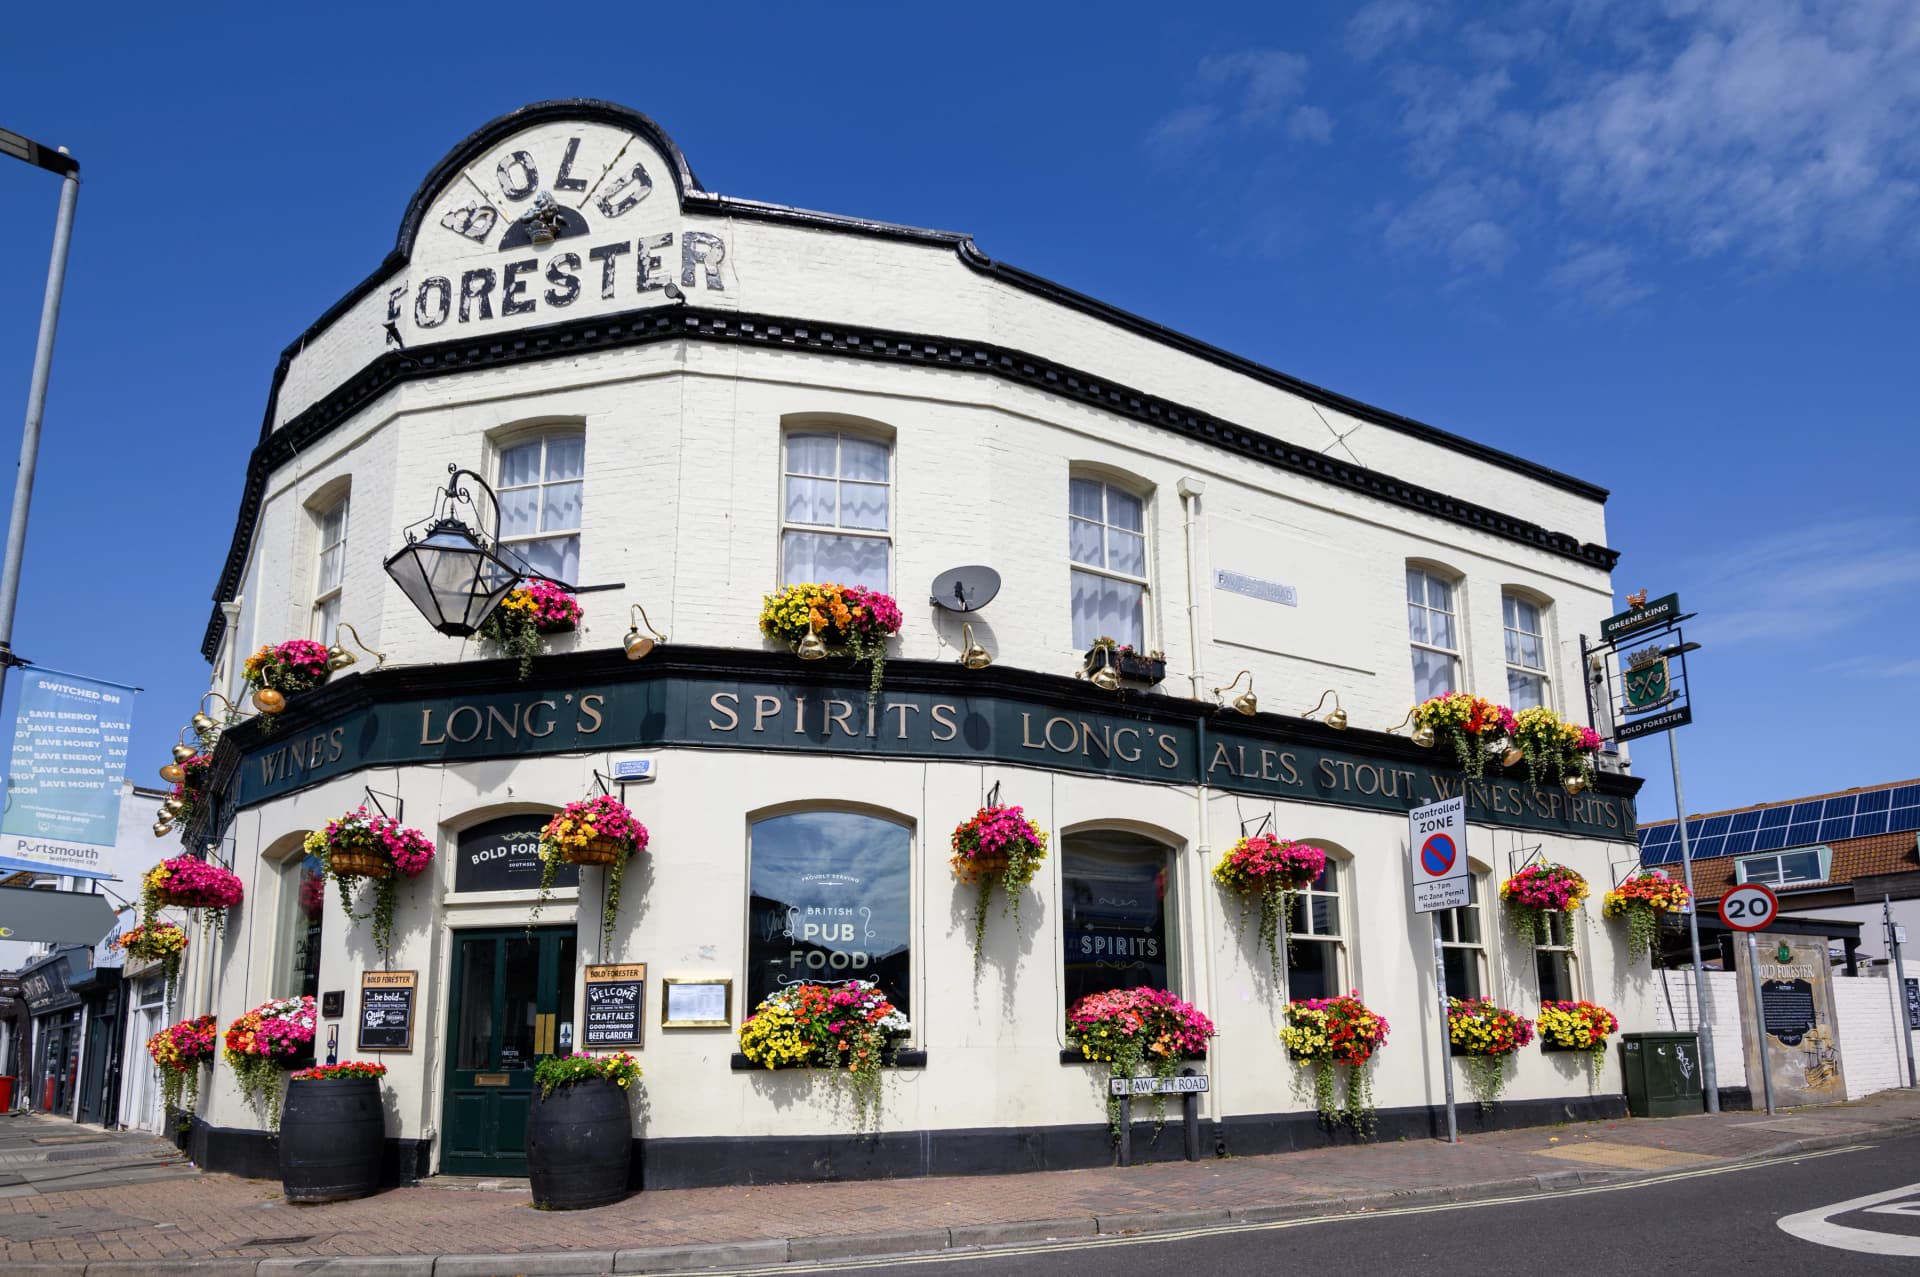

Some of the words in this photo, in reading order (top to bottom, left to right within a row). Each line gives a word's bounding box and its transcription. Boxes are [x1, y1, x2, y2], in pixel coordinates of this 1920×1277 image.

[441, 137, 653, 244] BOLD
[1608, 612, 1643, 631] GREENE
[1645, 604, 1669, 618] KING
[38, 681, 101, 700] SWITCHED
[102, 694, 121, 704] ON
[29, 710, 56, 719] SAVE
[58, 711, 98, 721] ENERGY
[420, 694, 605, 746] LONG'S
[709, 692, 957, 741] SPIRITS
[27, 724, 55, 732] SAVE
[56, 725, 100, 735] CARBON
[1621, 723, 1642, 736] BOLD
[1643, 713, 1684, 729] FORESTER
[35, 738, 62, 746] SAVE
[63, 739, 101, 749] MONEY
[104, 735, 129, 743] SAVE
[1021, 712, 1179, 768] LONG'S
[34, 752, 61, 760] SAVE
[62, 753, 103, 762] ENERGY
[260, 726, 344, 786] WINES
[32, 766, 58, 775] SAVE
[60, 767, 105, 776] CARBON
[40, 780, 67, 789] SAVE
[67, 781, 105, 790] MONEY
[1208, 742, 1304, 787] ALES,
[1431, 774, 1523, 816] WINES
[1535, 791, 1619, 829] SPIRITS
[1413, 801, 1461, 820] Controlled
[1420, 816, 1454, 833] ZONE
[17, 840, 99, 859] Portsmouth
[472, 846, 507, 864] BOLD
[1445, 888, 1464, 897] Permit
[1423, 901, 1445, 909] Holders
[1447, 897, 1460, 905] Only
[1728, 897, 1768, 919] 20
[807, 907, 853, 917] BRITISH
[804, 923, 855, 942] PUB
[1081, 935, 1158, 957] SPIRITS
[790, 951, 869, 969] FOOD
[590, 970, 606, 978] BOLD
[607, 969, 639, 977] FORESTER
[1757, 963, 1775, 978] OLD
[367, 976, 381, 984] BOLD
[382, 975, 411, 984] FORESTER
[374, 992, 383, 1001] be
[383, 991, 400, 1001] bold
[590, 987, 637, 1002] WELCOME
[590, 1012, 616, 1021] CRAFT
[616, 1012, 635, 1020] ALES
[588, 1031, 604, 1040] BEER
[605, 1031, 633, 1040] GARDEN
[1179, 1079, 1207, 1090] ROAD
